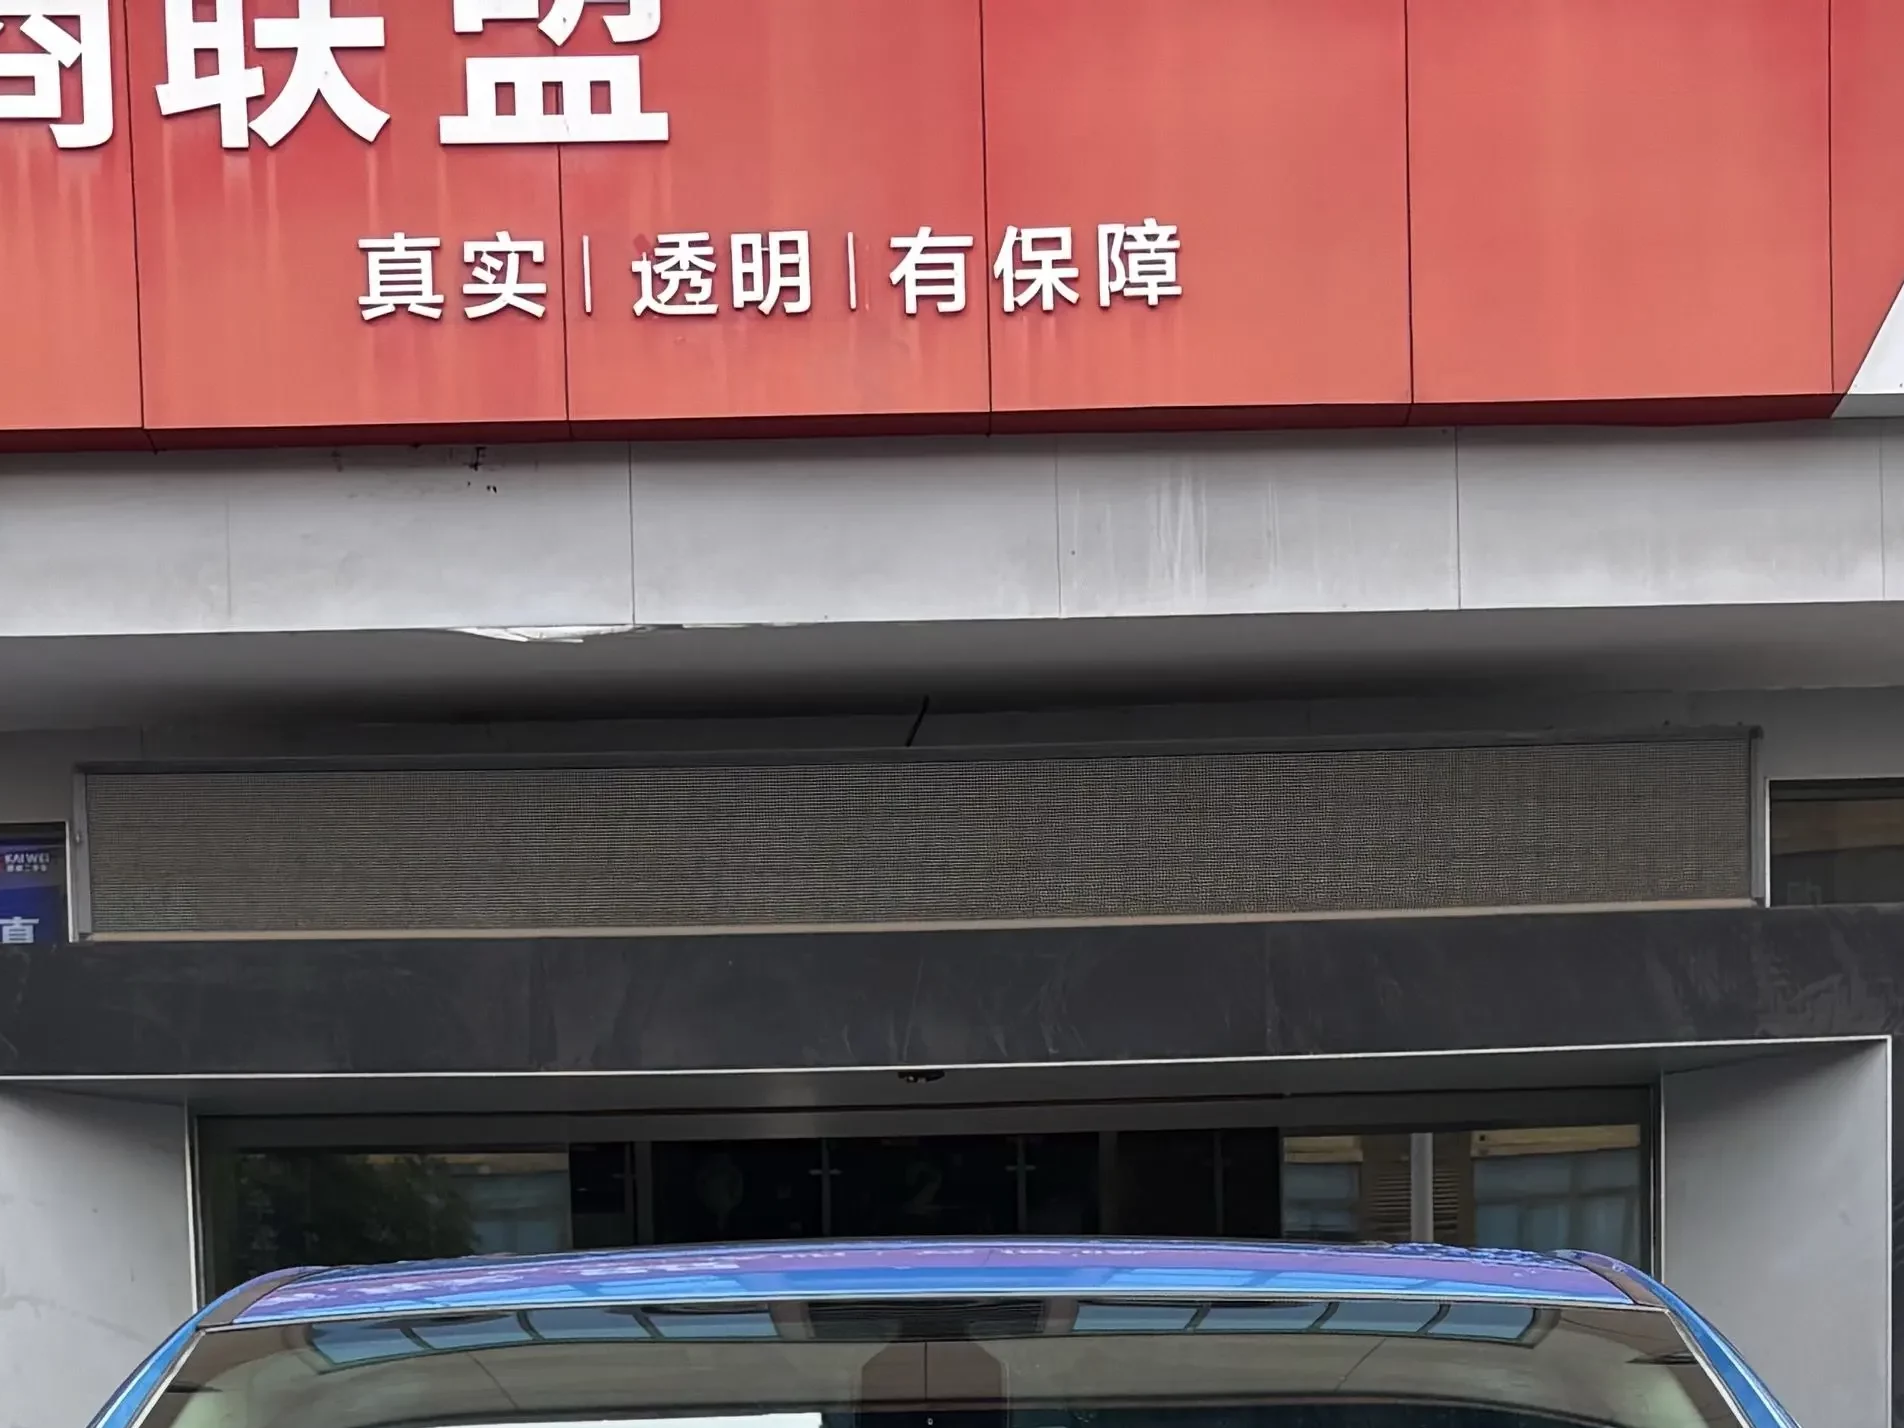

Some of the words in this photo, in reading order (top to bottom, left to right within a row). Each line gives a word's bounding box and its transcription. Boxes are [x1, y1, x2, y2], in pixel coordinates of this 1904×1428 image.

[357, 230, 548, 320] 真实
[631, 229, 812, 317] 透明
[888, 217, 1183, 315] 有保障
